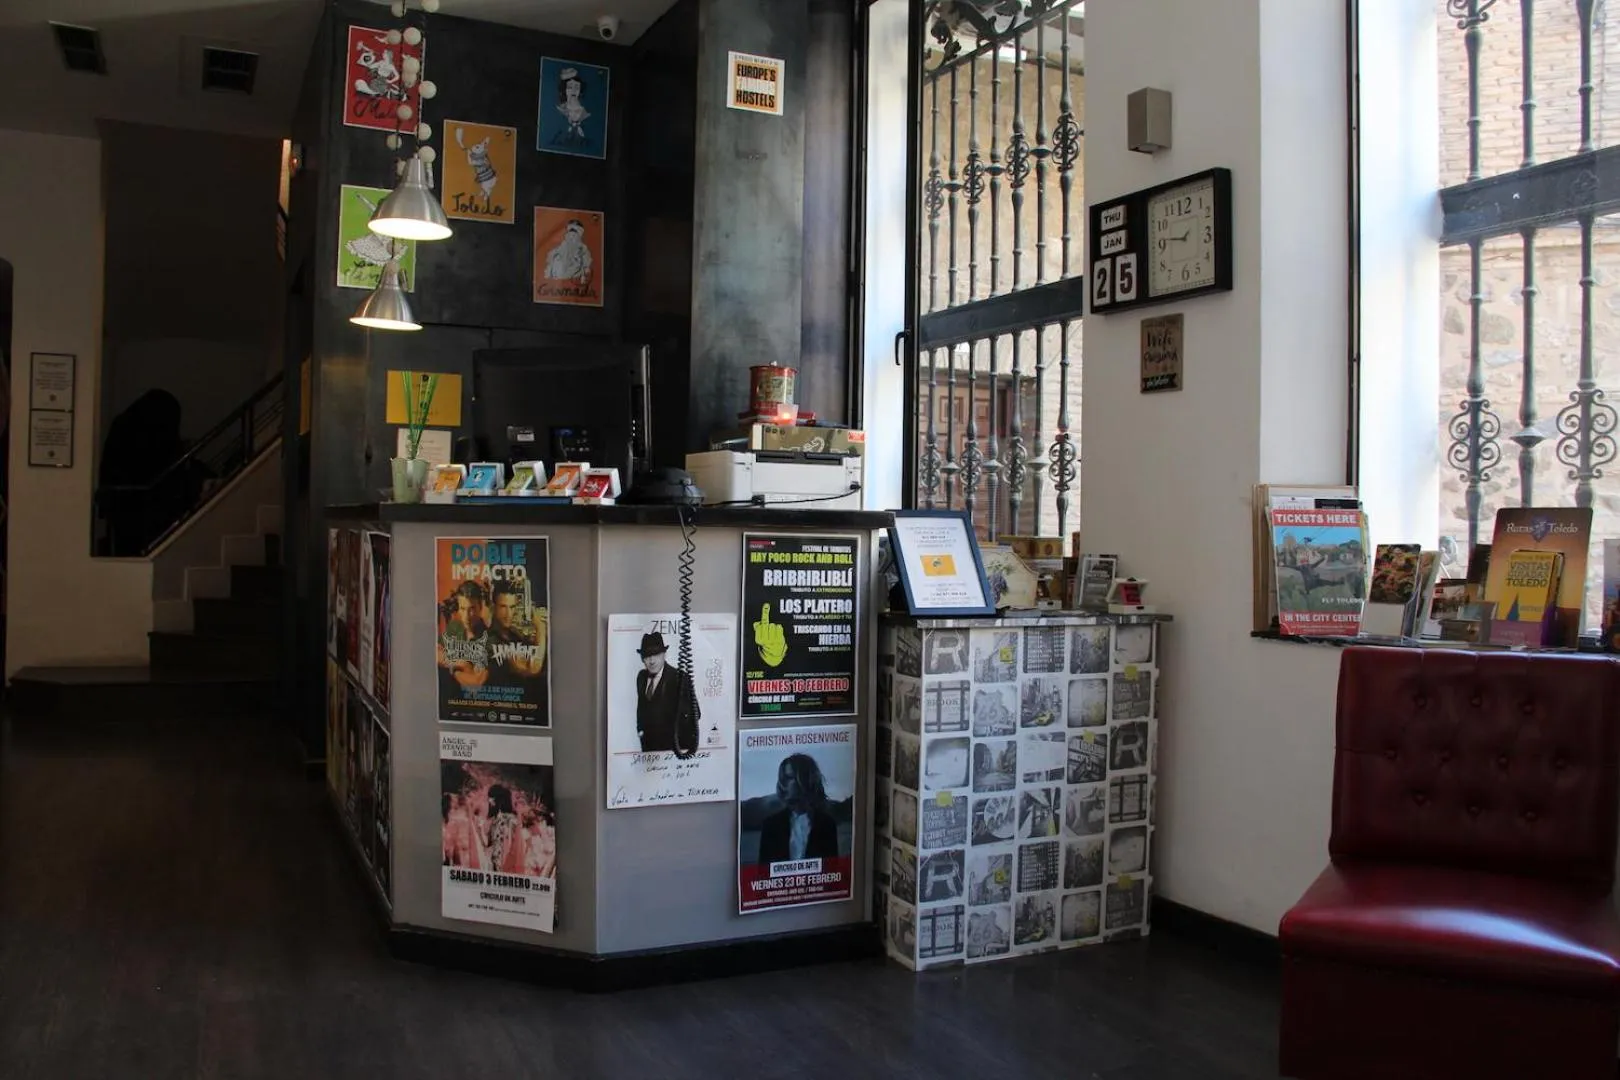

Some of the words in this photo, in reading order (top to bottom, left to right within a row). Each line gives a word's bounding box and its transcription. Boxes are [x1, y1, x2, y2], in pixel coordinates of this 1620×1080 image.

[736, 63, 776, 81] EUROPE'S
[736, 89, 775, 108] HOSTELS
[452, 192, 506, 216] Toledo
[1164, 203, 1174, 217] 11
[1176, 196, 1192, 217] 12
[1104, 211, 1121, 225] THU
[1158, 218, 1168, 232] 10
[1204, 205, 1211, 219] 2
[1104, 236, 1122, 250] JAN
[1158, 239, 1167, 255] 9
[1203, 225, 1212, 244] 3
[1181, 263, 1191, 281] 6
[1275, 513, 1324, 524] TICKETS
[1326, 513, 1357, 524] HERE
[1548, 522, 1578, 534] Toledo
[451, 543, 527, 565] DOBLE
[768, 552, 791, 564] POCO
[792, 552, 815, 564] ROCK
[834, 554, 853, 565] ROLL
[451, 564, 527, 581] IMPACTO
[763, 567, 853, 587] BRIBRIBLIBLÍ
[1507, 578, 1548, 588] TOLEDO
[780, 598, 802, 614] LOS
[803, 598, 853, 614] PLATERO
[1295, 613, 1311, 622] THE
[1312, 613, 1331, 622] CITY
[651, 619, 693, 635] ZENE
[843, 624, 852, 633] LA
[747, 679, 791, 695] VIERNES
[791, 679, 805, 693] 16
[805, 678, 849, 693] FEBRERO
[746, 735, 793, 748] CHRISTINA
[795, 732, 850, 745] ROSENVINGE
[486, 873, 492, 885] 3
[493, 874, 531, 890] FEBRERO
[751, 877, 783, 891] VIERNES
[785, 876, 795, 886] 23
[796, 875, 806, 886] DE
[807, 872, 842, 885] FEBRERO
